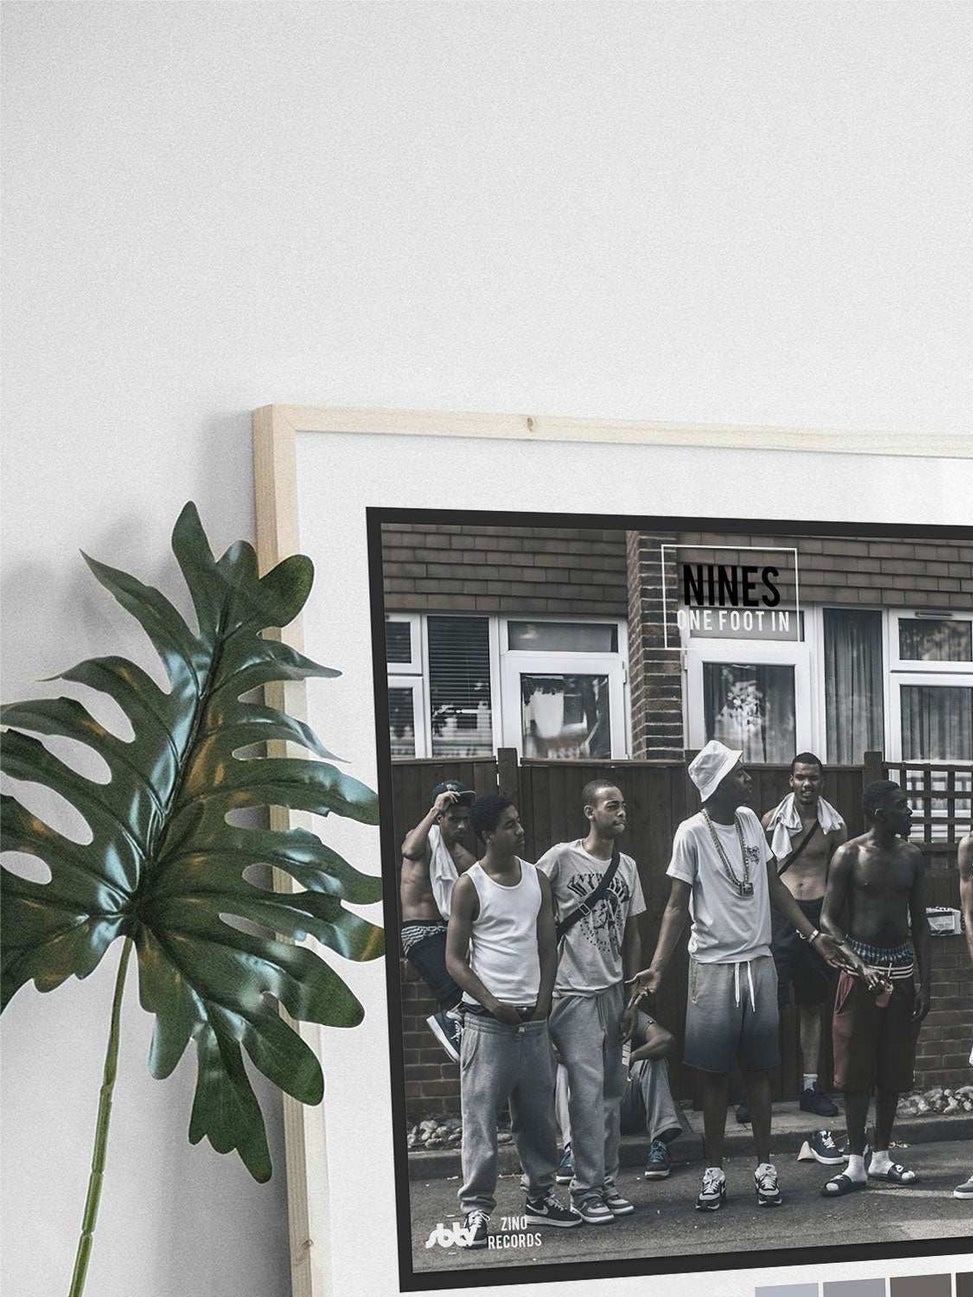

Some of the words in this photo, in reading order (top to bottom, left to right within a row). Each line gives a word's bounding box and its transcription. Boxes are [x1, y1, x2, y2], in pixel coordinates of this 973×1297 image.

[683, 564, 781, 607] NINES
[677, 609, 713, 631] ONE
[719, 610, 765, 631] FOOT
[771, 611, 789, 632] IN
[500, 1216, 528, 1232] ZINO
[487, 1232, 542, 1250] RECORDS
